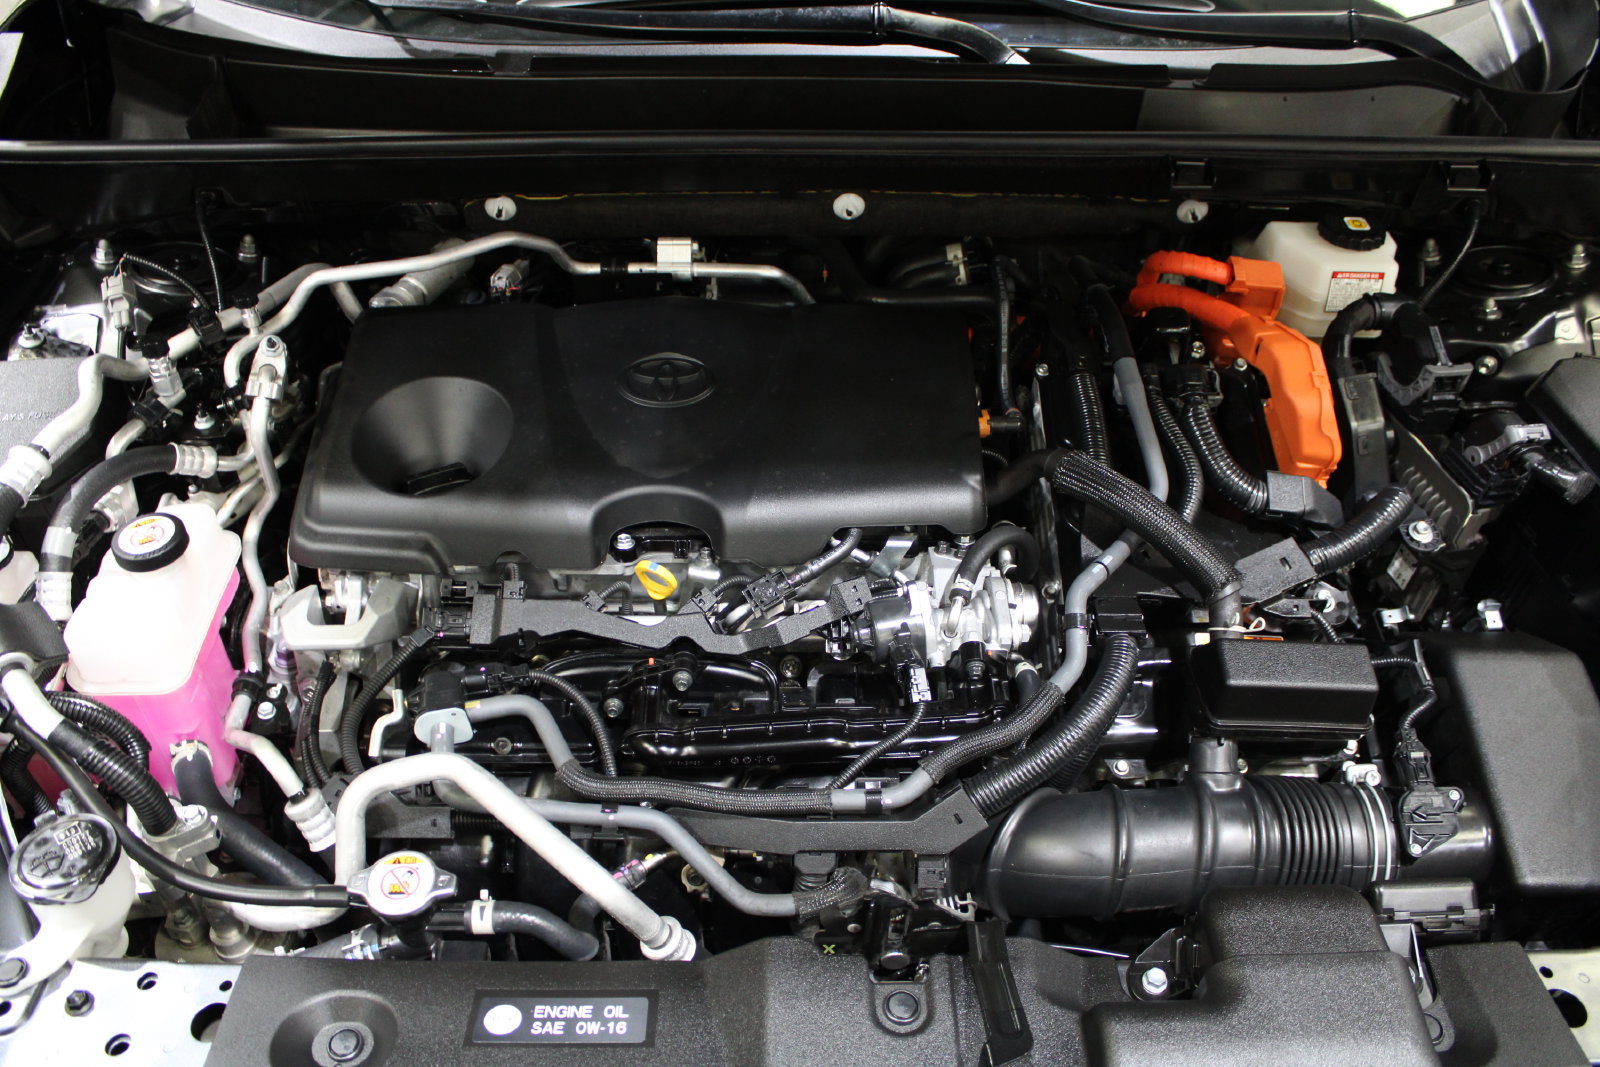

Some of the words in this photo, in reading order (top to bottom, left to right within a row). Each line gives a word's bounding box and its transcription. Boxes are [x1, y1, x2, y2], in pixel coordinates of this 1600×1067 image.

[533, 1005, 594, 1019] ENGINE
[603, 1005, 630, 1019] OIL
[530, 1021, 566, 1035] SAE
[575, 1021, 628, 1035] 0W-16
